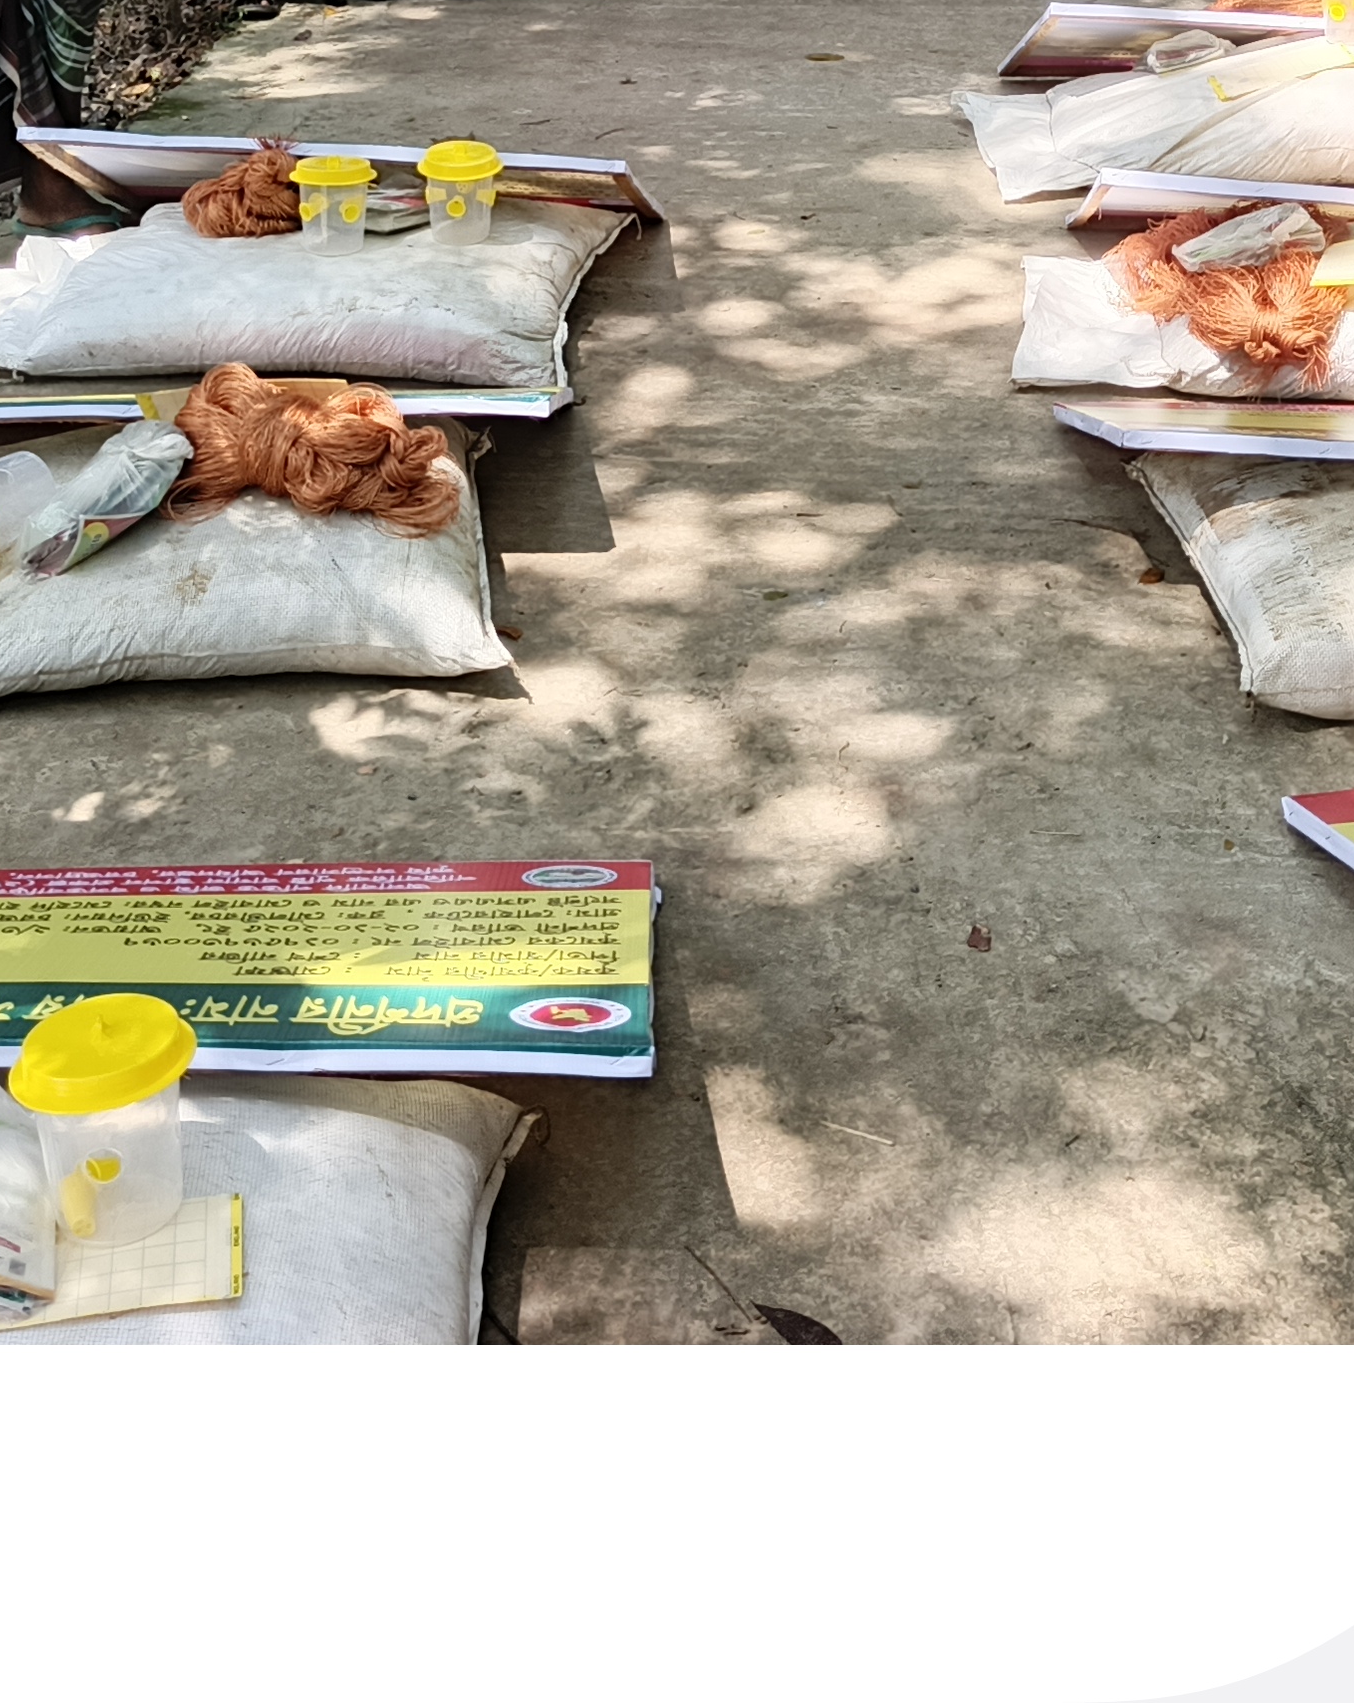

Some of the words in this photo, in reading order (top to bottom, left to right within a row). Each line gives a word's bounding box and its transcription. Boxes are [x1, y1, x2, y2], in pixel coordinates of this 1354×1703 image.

[192, 898, 291, 910] মোবাইল
[331, 898, 374, 907] নাম
[383, 898, 421, 906] এর
[0, 923, 50, 935] ২/৩
[451, 922, 525, 935] তারিখ
[535, 921, 619, 935] প্রদর্শনী
[370, 936, 401, 946] নং
[411, 936, 515, 949] মোবাইল
[527, 931, 620, 945] কৃষকের
[199, 951, 276, 964] নাজির
[285, 951, 340, 962] শেখ
[411, 951, 459, 961] নাম
[173, 995, 278, 1025] নাম:
[293, 995, 481, 1034] প্রদর্শনীর
